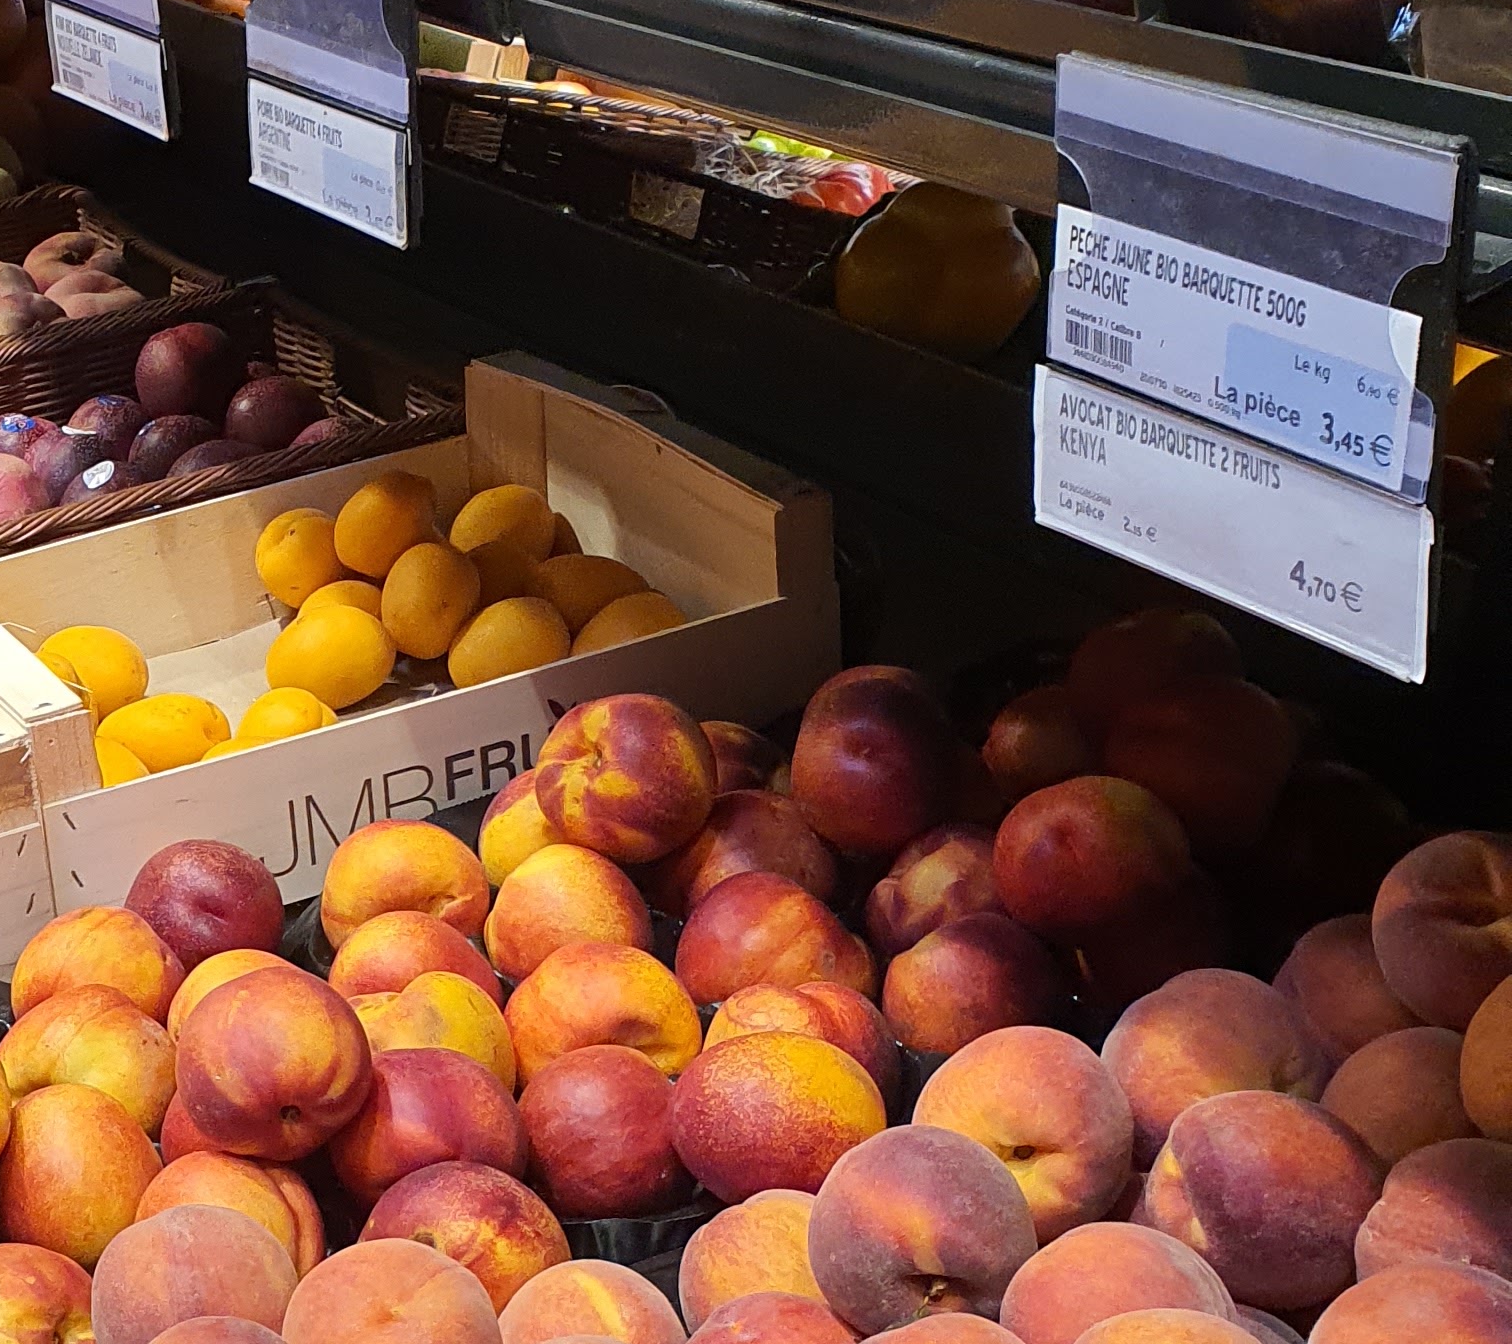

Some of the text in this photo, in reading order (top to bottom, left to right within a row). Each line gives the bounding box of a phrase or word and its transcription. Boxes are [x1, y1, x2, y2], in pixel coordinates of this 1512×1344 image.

[322, 124, 343, 149] FRUITS
[1067, 258, 1131, 307] ESPAGNE
[1069, 224, 1307, 327] PECHE JAUNE BIO BARQUETTE 500G
[1294, 354, 1311, 373] Le
[1315, 361, 1331, 384] kg
[1387, 388, 1400, 406] €
[1059, 392, 1281, 490] AVOCAT BIO BARQUETTE 2 FRUITS
[1059, 423, 1107, 466] KENYA
[1214, 375, 1238, 404] La
[1245, 391, 1301, 427] pièce
[1319, 412, 1365, 457] 3,45
[1369, 434, 1394, 467] €
[1289, 560, 1363, 613] 4,70 €
